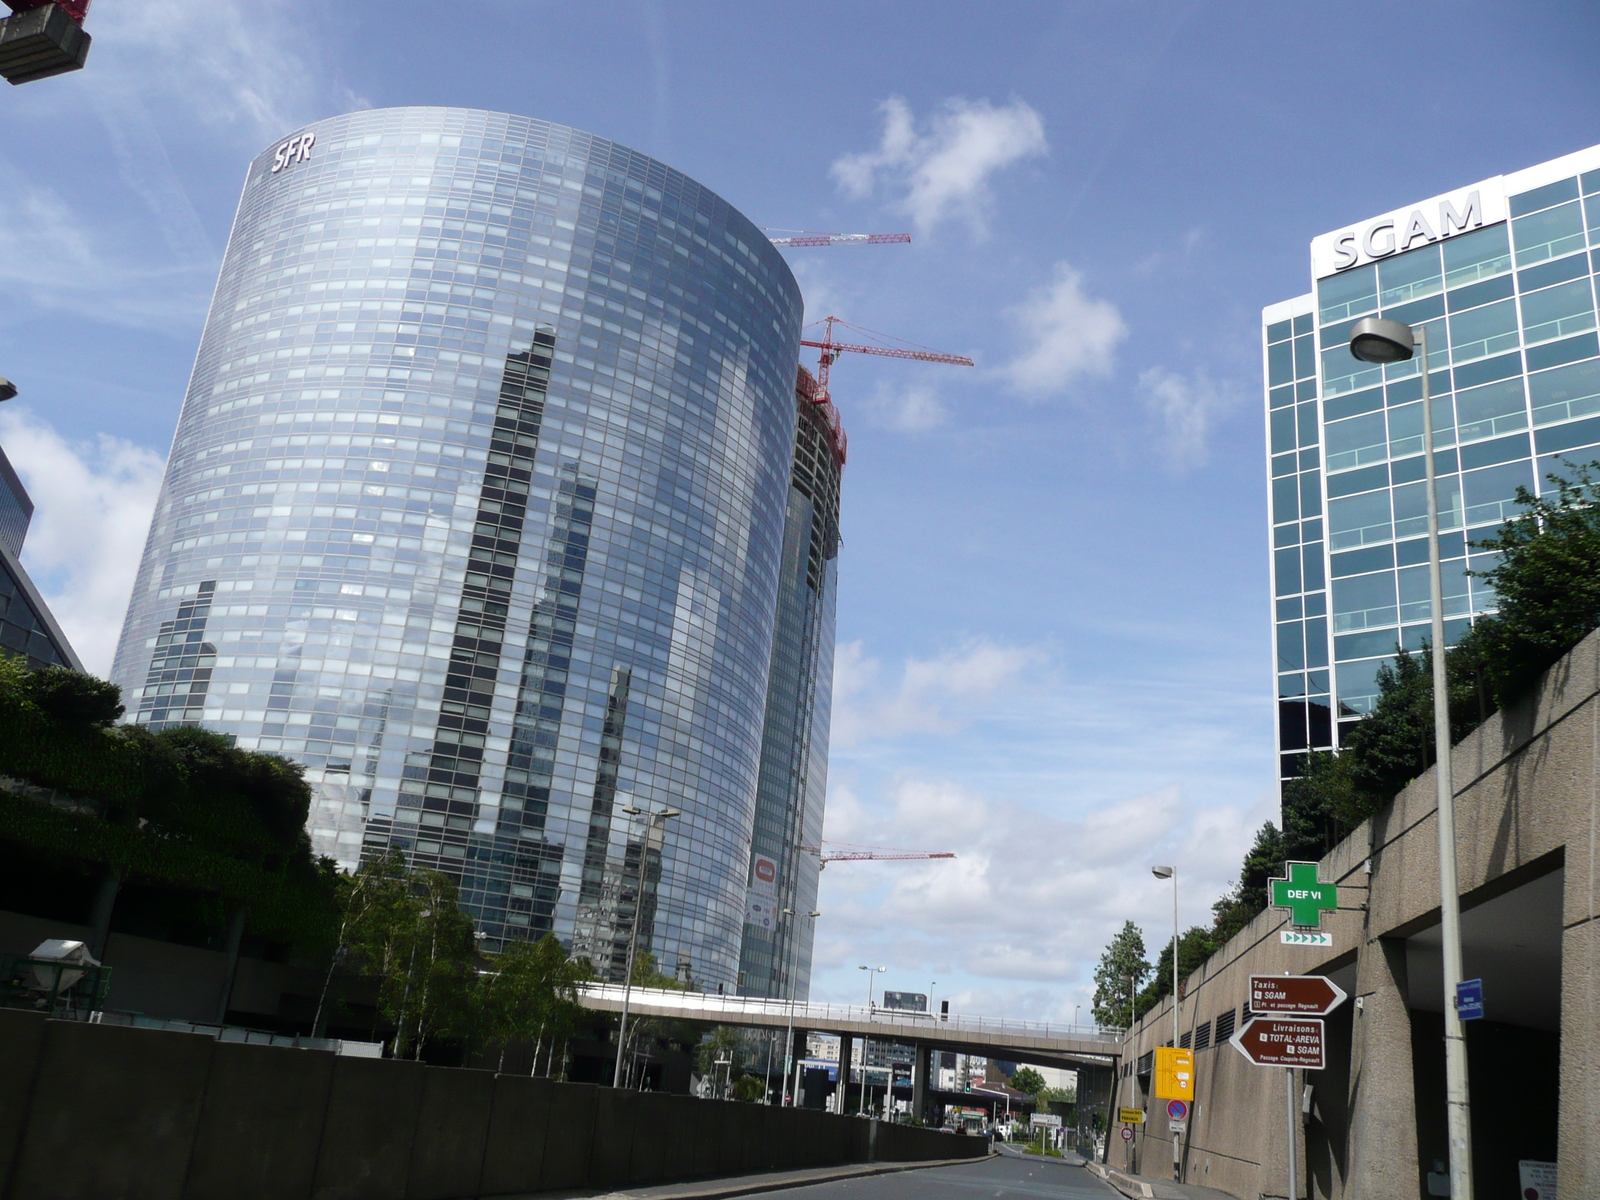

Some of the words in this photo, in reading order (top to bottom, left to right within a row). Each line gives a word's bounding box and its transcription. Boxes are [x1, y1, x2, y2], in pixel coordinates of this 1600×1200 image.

[271, 132, 315, 173] SFR
[1333, 190, 1482, 270] SGAM
[1287, 889, 1309, 899] DEF
[1310, 890, 1321, 900] VI
[1264, 991, 1286, 1000] SGAM
[1269, 1034, 1320, 1044] TOTAL-AREVA
[1297, 1045, 1320, 1055] SGAM
[1259, 1054, 1279, 1062] Passage
